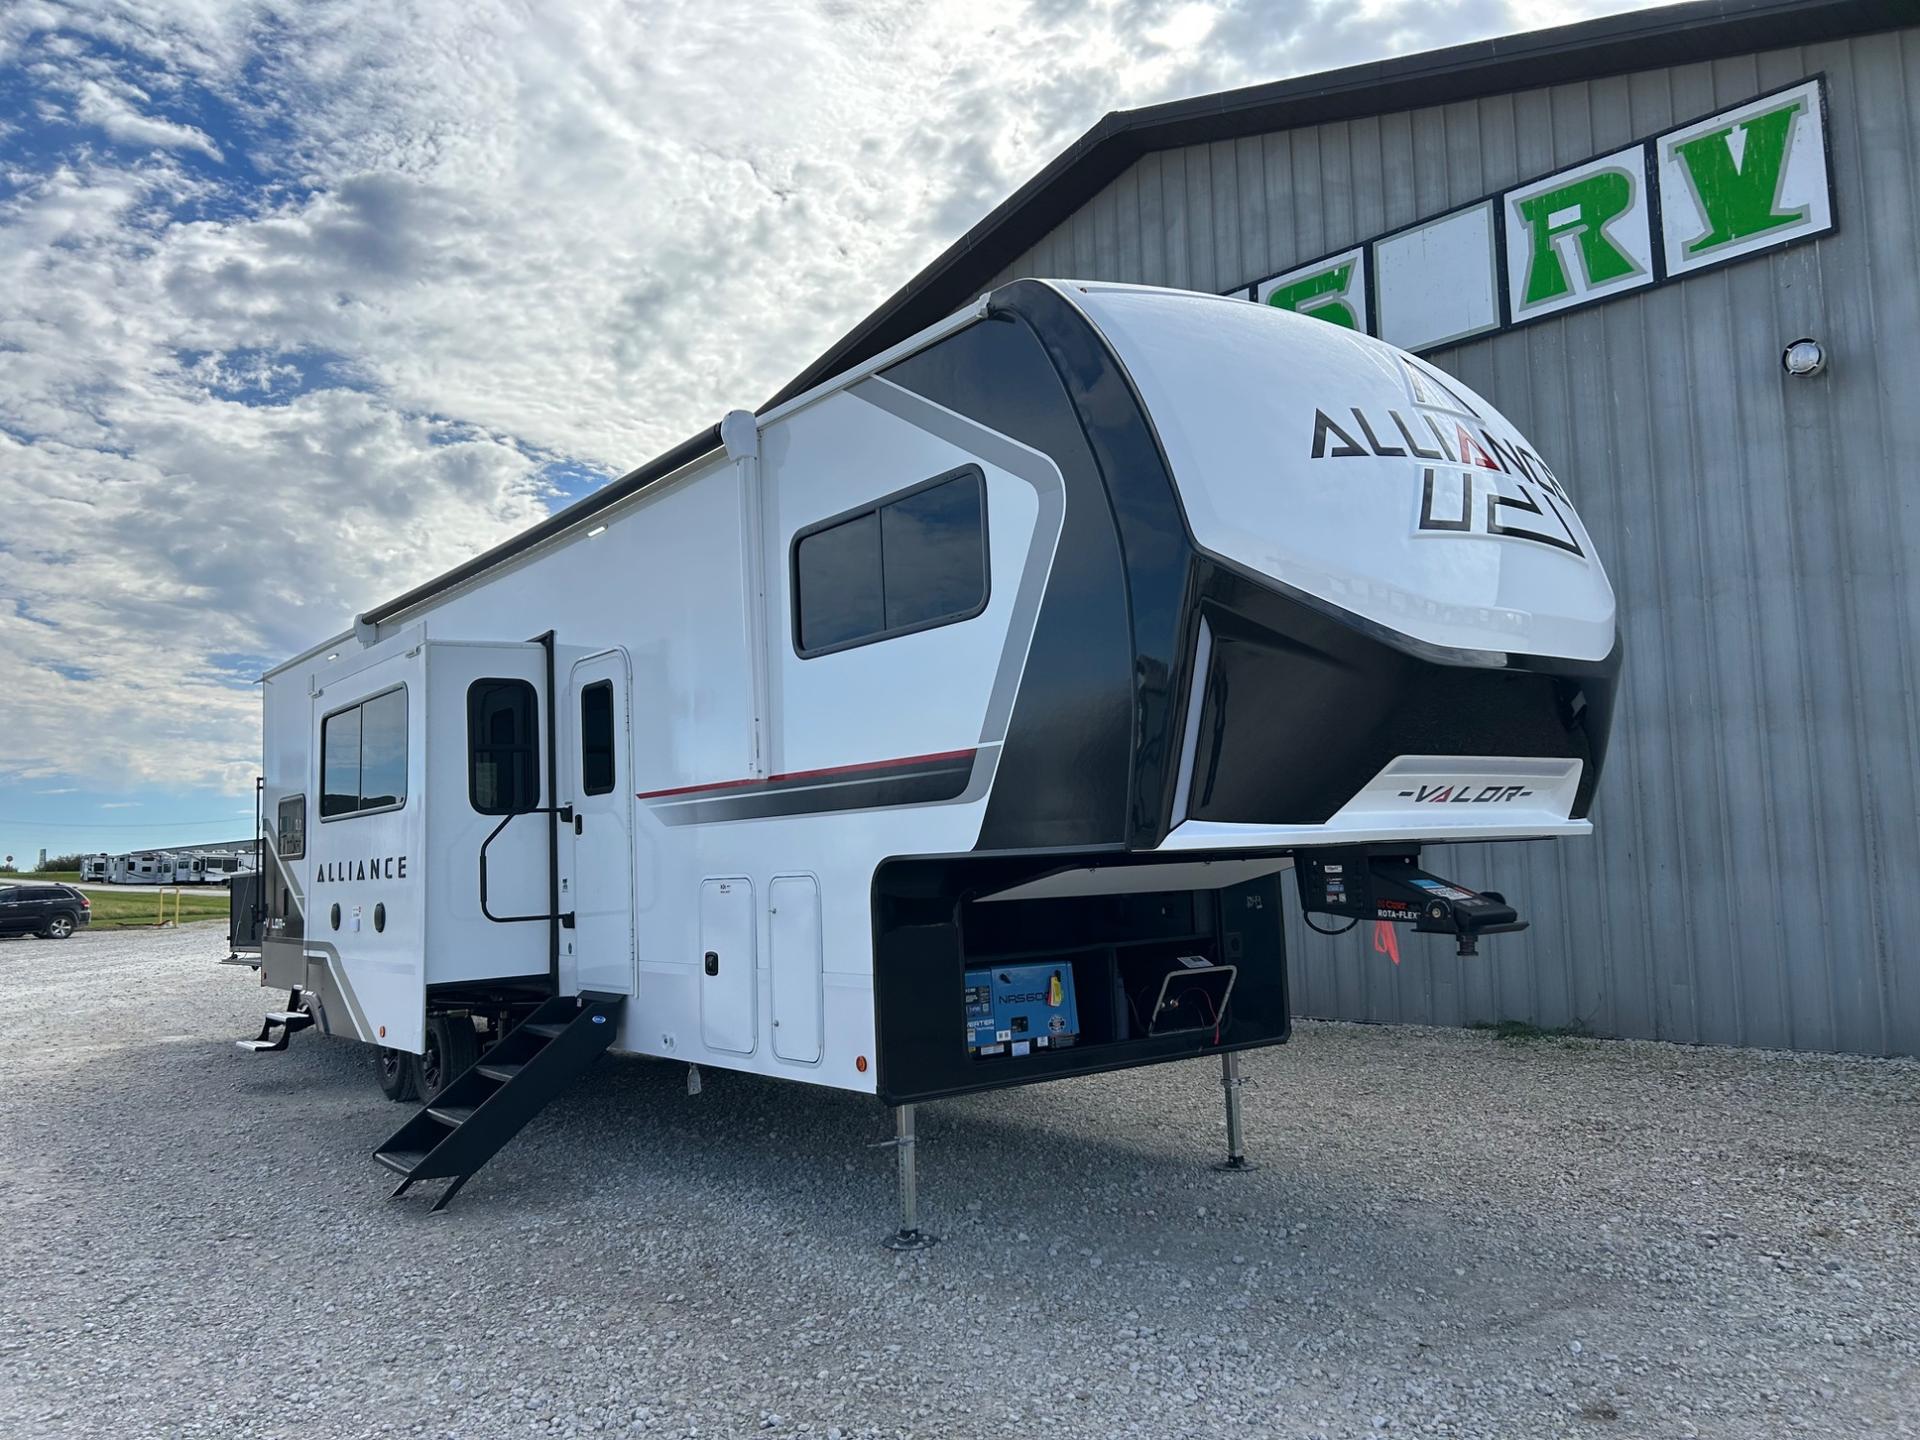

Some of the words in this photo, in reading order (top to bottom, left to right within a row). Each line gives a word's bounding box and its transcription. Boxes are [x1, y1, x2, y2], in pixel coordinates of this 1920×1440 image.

[1512, 94, 1809, 312] RV
[1310, 407, 1573, 511] ALLIANCE
[316, 856, 407, 883] ALLIANCE
